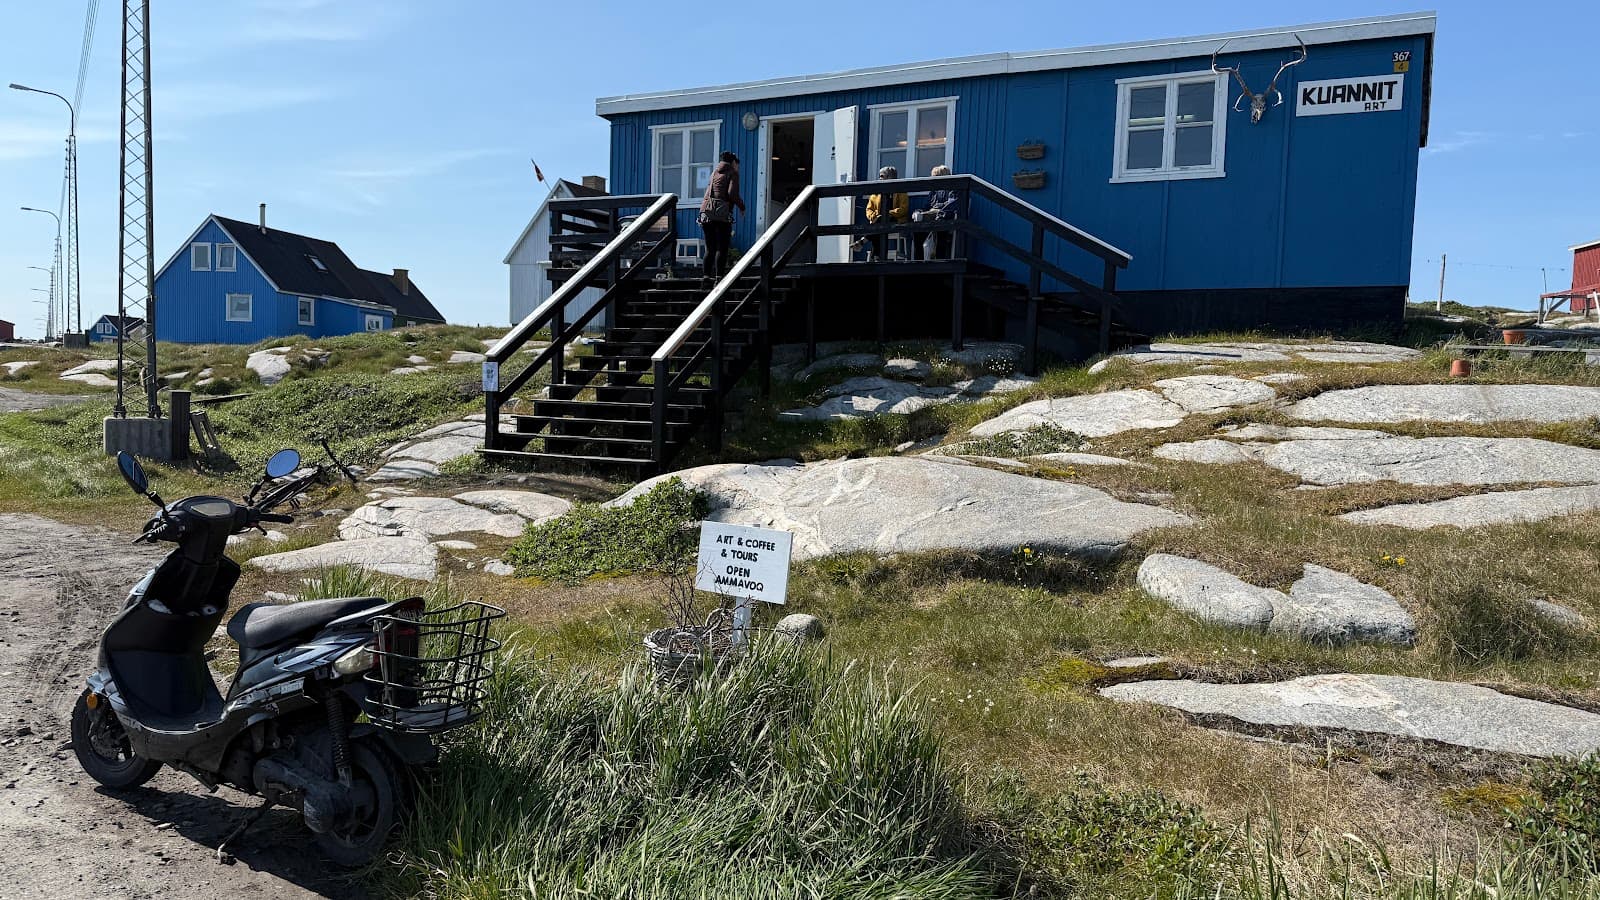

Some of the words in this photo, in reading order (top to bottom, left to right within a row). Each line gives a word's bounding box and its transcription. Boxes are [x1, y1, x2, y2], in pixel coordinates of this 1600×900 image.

[1392, 51, 1409, 62] 367
[1302, 81, 1398, 106] KUANNIT
[1364, 101, 1387, 111] ART
[716, 535, 733, 545] ART
[737, 537, 743, 546] &
[745, 539, 776, 551] COFFEE
[721, 548, 727, 557] &
[731, 549, 758, 562] TOURS
[726, 565, 750, 577] OPEN
[715, 575, 764, 592] AMMAVOQ
